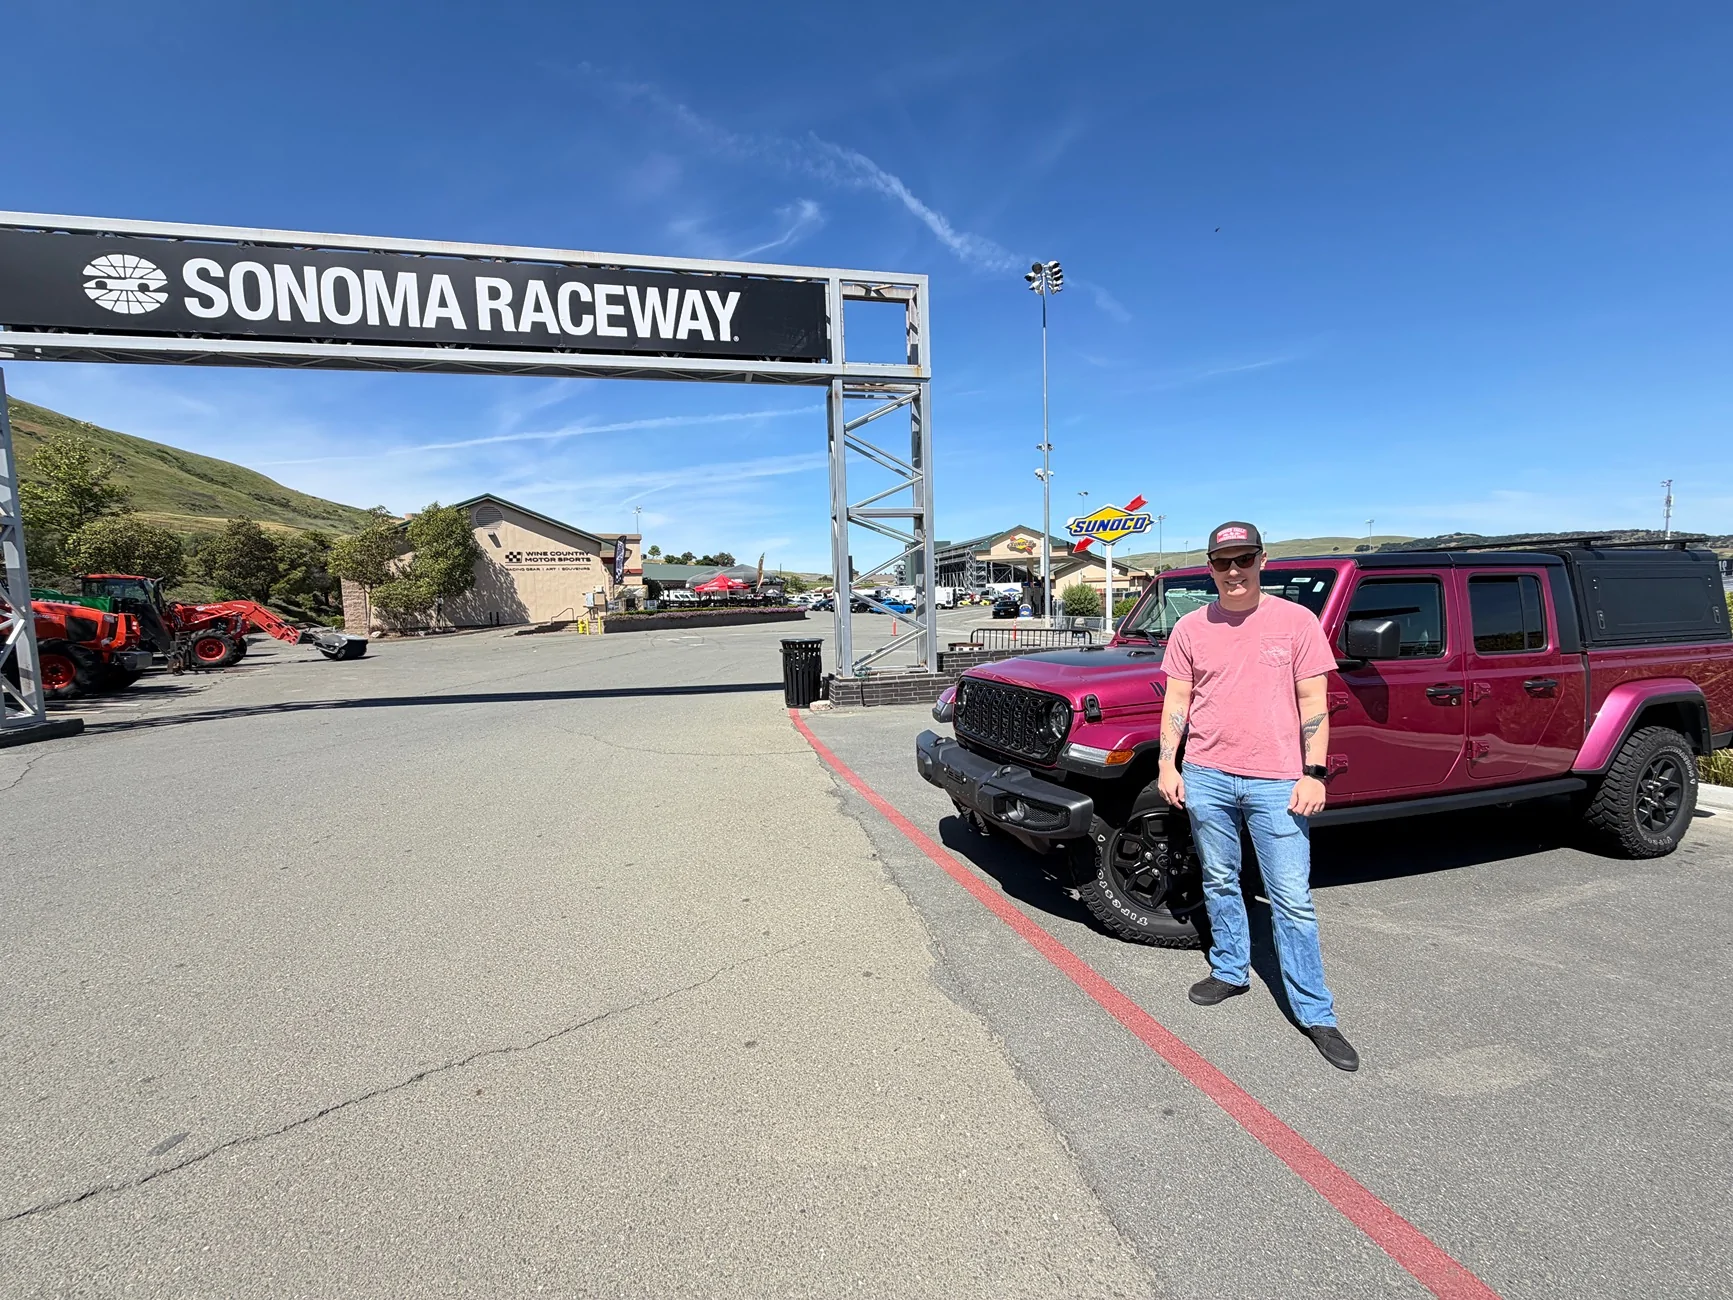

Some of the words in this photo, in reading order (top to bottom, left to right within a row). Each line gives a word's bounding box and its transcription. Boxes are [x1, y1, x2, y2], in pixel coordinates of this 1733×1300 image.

[182, 257, 467, 330] SONOMA
[474, 276, 741, 342] RACEWAY
[1073, 517, 1147, 533] SUNOCO
